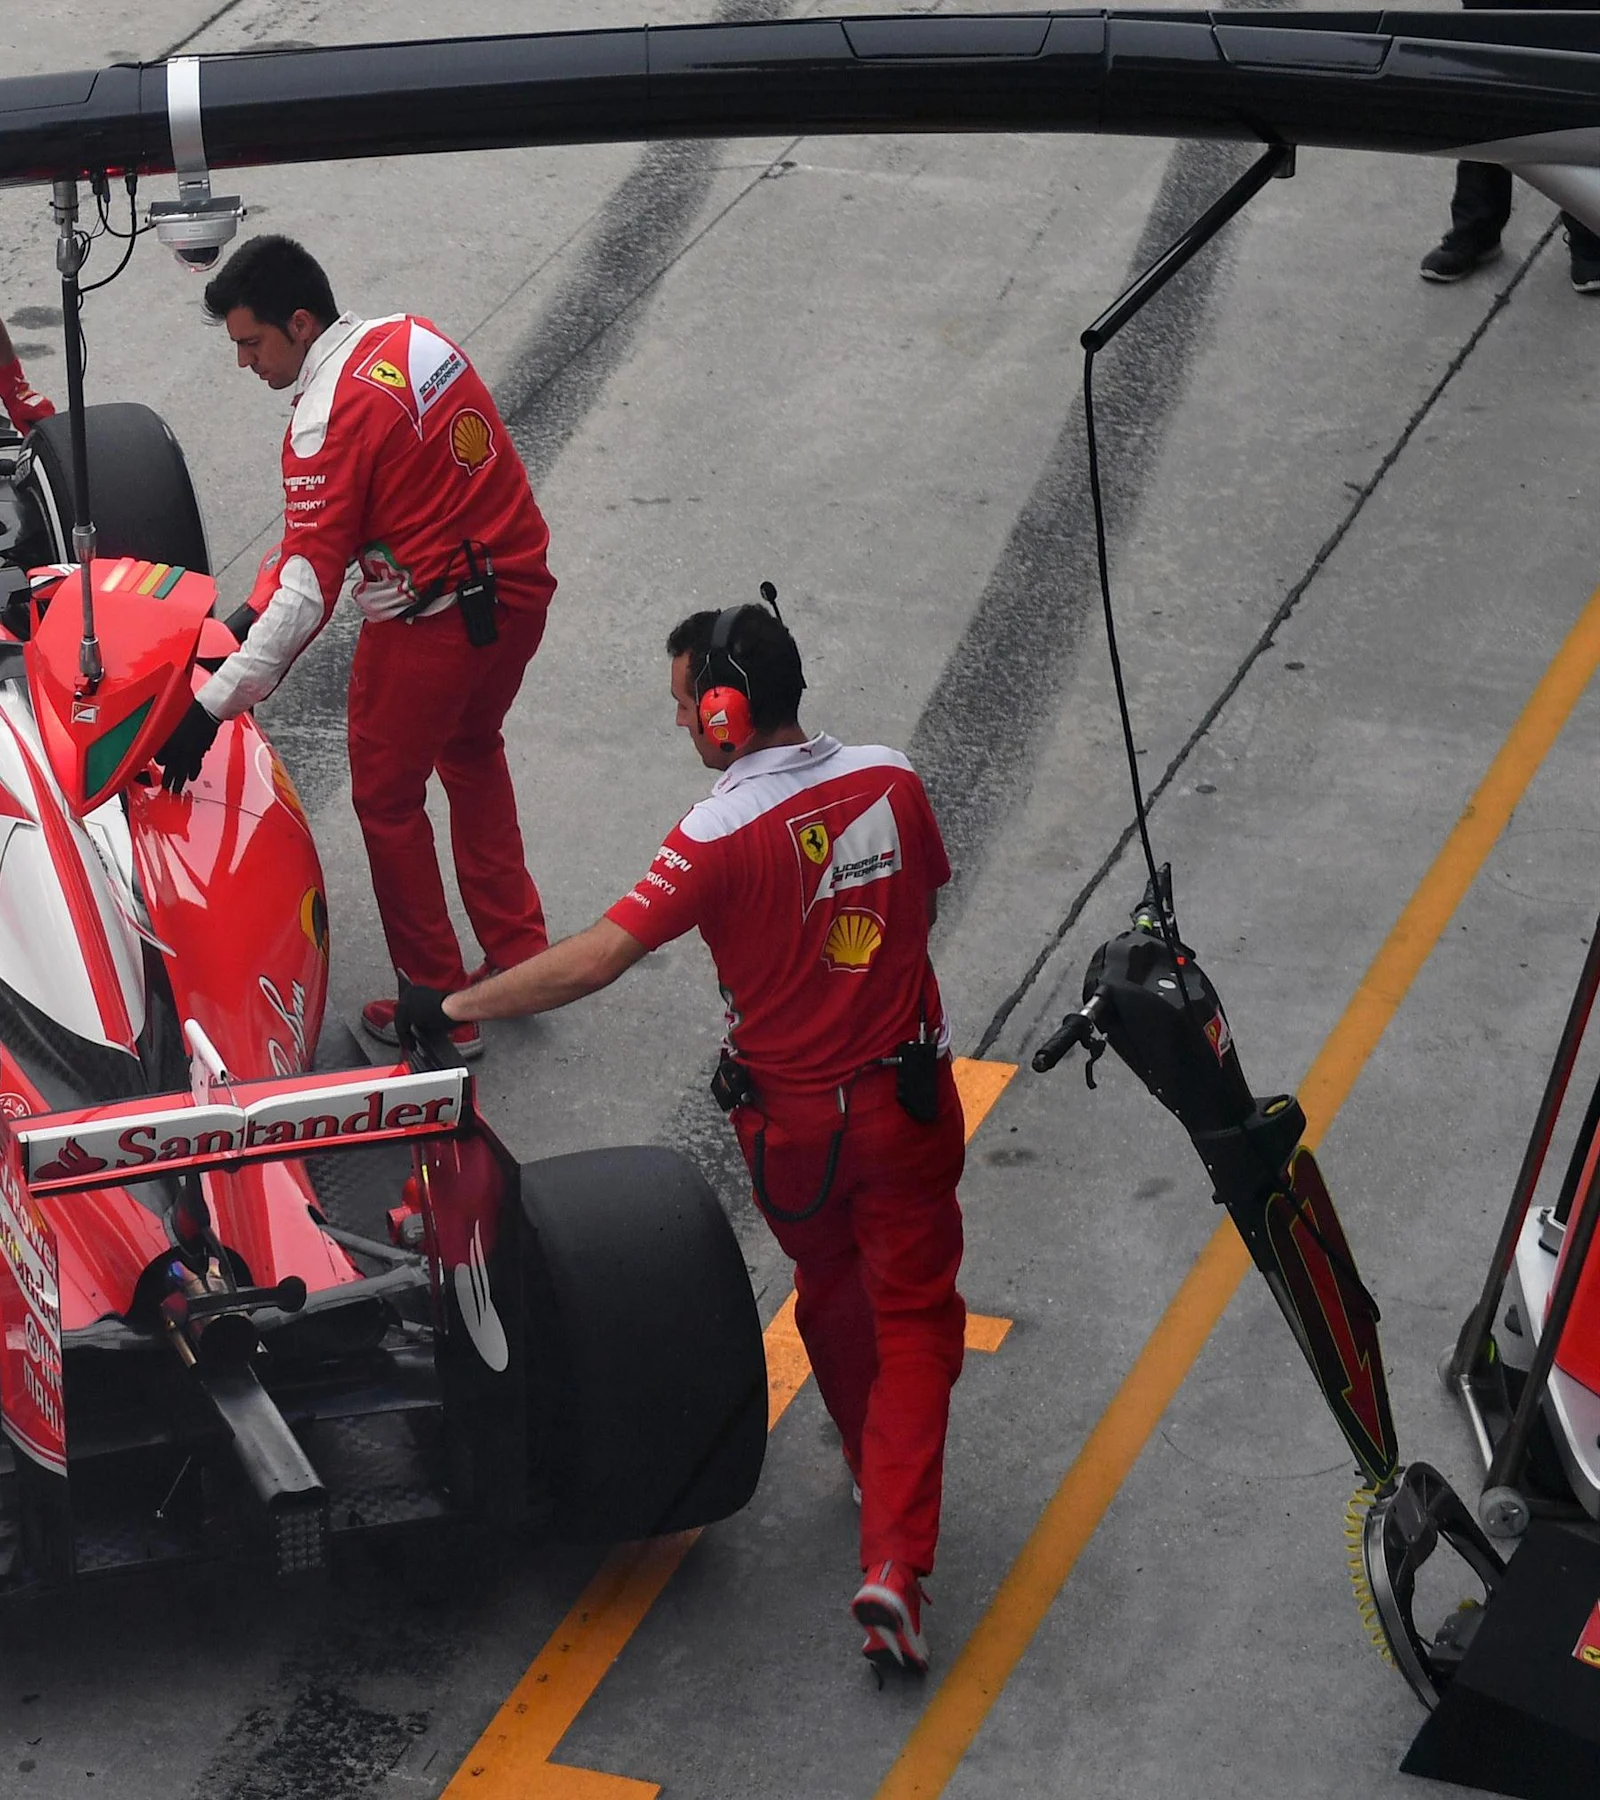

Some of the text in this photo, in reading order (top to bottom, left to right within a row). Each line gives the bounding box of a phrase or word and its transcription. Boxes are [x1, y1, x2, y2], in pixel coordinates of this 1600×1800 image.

[418, 359, 451, 396] SCUDERIA
[658, 845, 693, 873] CHAI
[844, 860, 894, 880] FERRAR
[114, 1091, 455, 1169] Santander
[23, 1356, 64, 1440] MAHL
